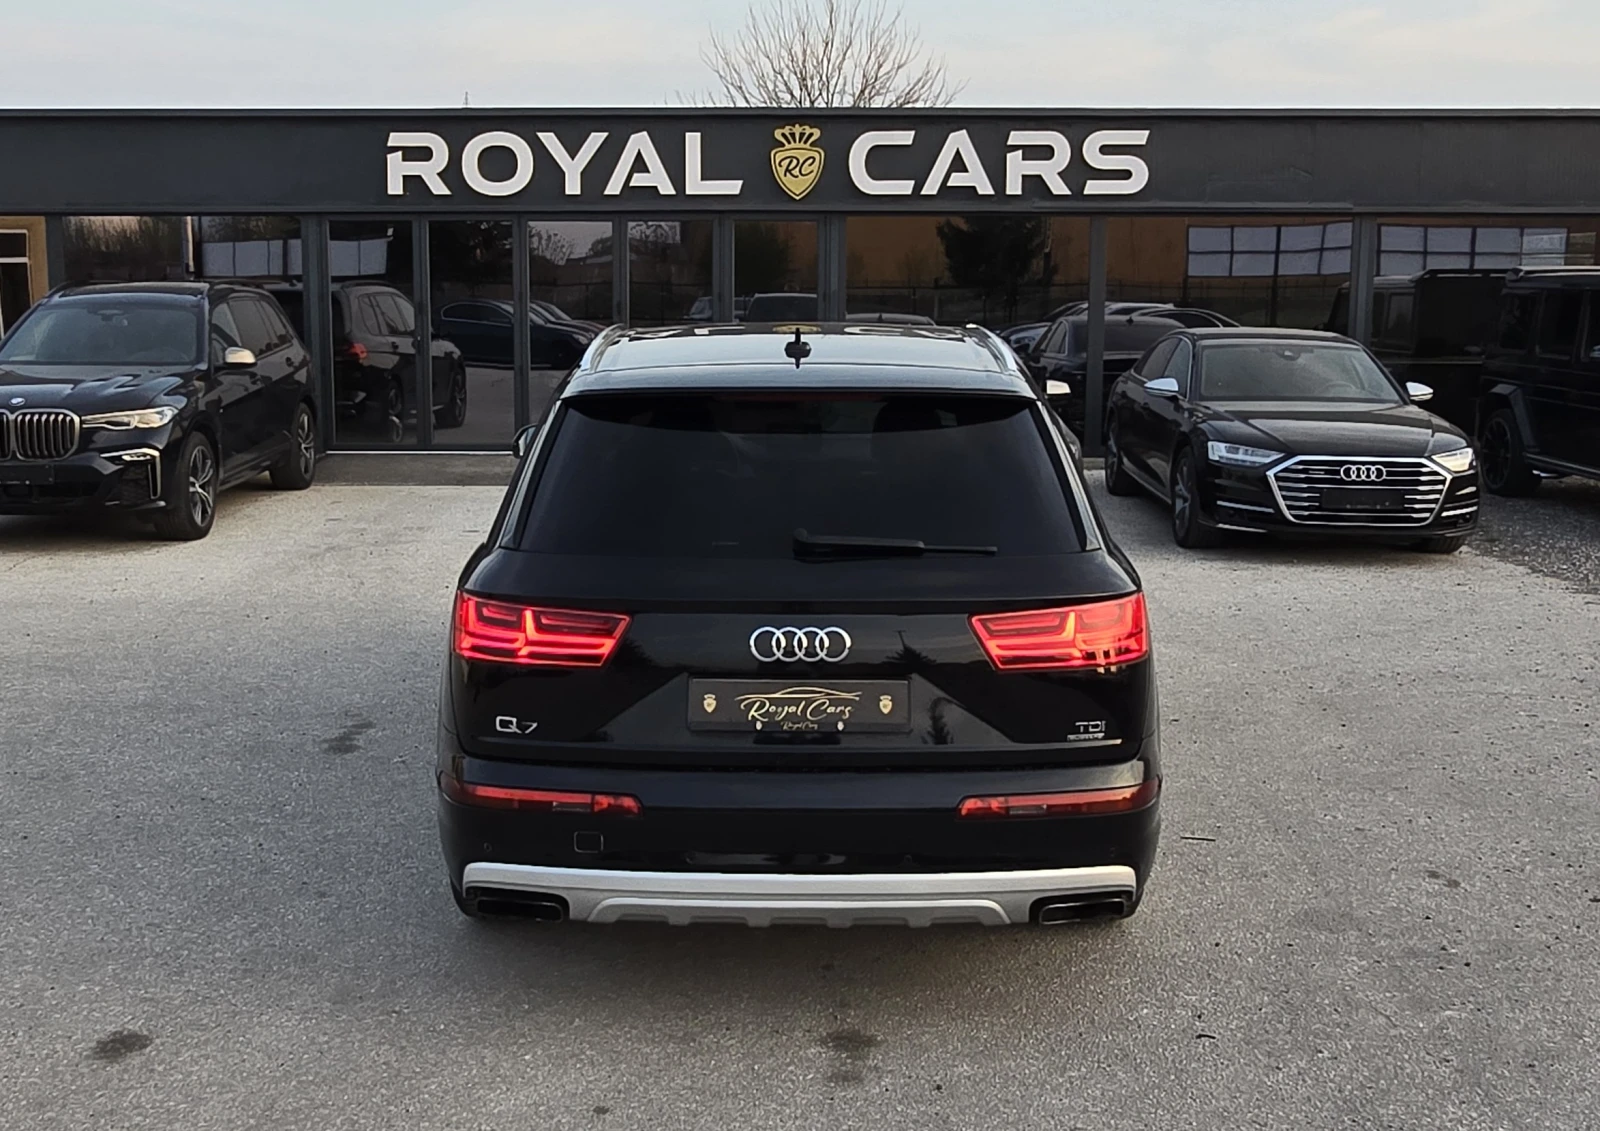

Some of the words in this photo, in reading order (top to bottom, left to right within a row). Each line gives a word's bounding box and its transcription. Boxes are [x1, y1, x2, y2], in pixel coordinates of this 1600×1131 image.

[387, 131, 743, 196] ROYAL
[848, 129, 1150, 195] CARS
[778, 155, 816, 178] RC
[740, 698, 805, 721] Royal
[806, 699, 853, 719] Cars
[495, 715, 538, 734] Q7
[1075, 720, 1106, 732] TDI
